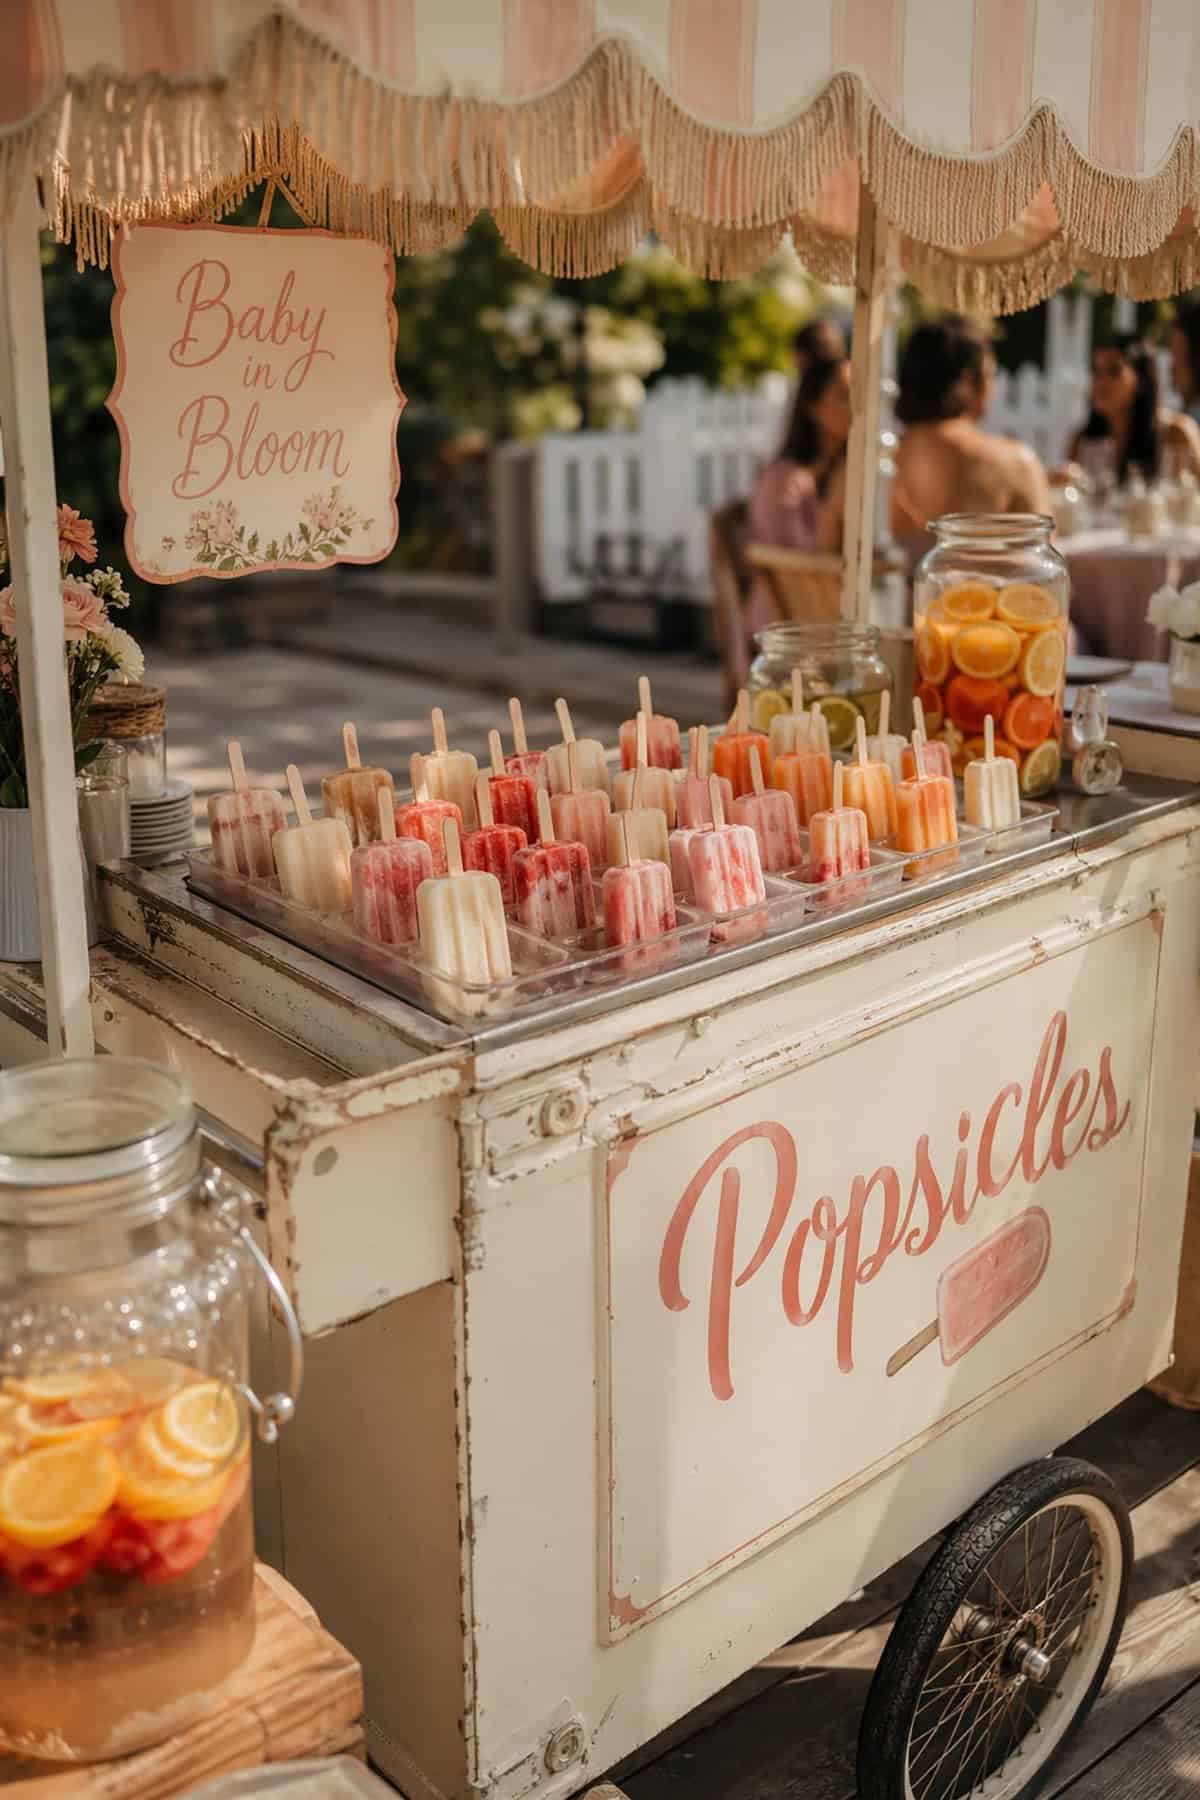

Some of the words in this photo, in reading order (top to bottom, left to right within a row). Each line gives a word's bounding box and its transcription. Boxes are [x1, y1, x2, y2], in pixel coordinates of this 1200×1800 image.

[169, 259, 335, 392] Baby
[242, 355, 277, 391] in
[171, 395, 350, 499] Bloom
[658, 1010, 1131, 1400] Popsicles
